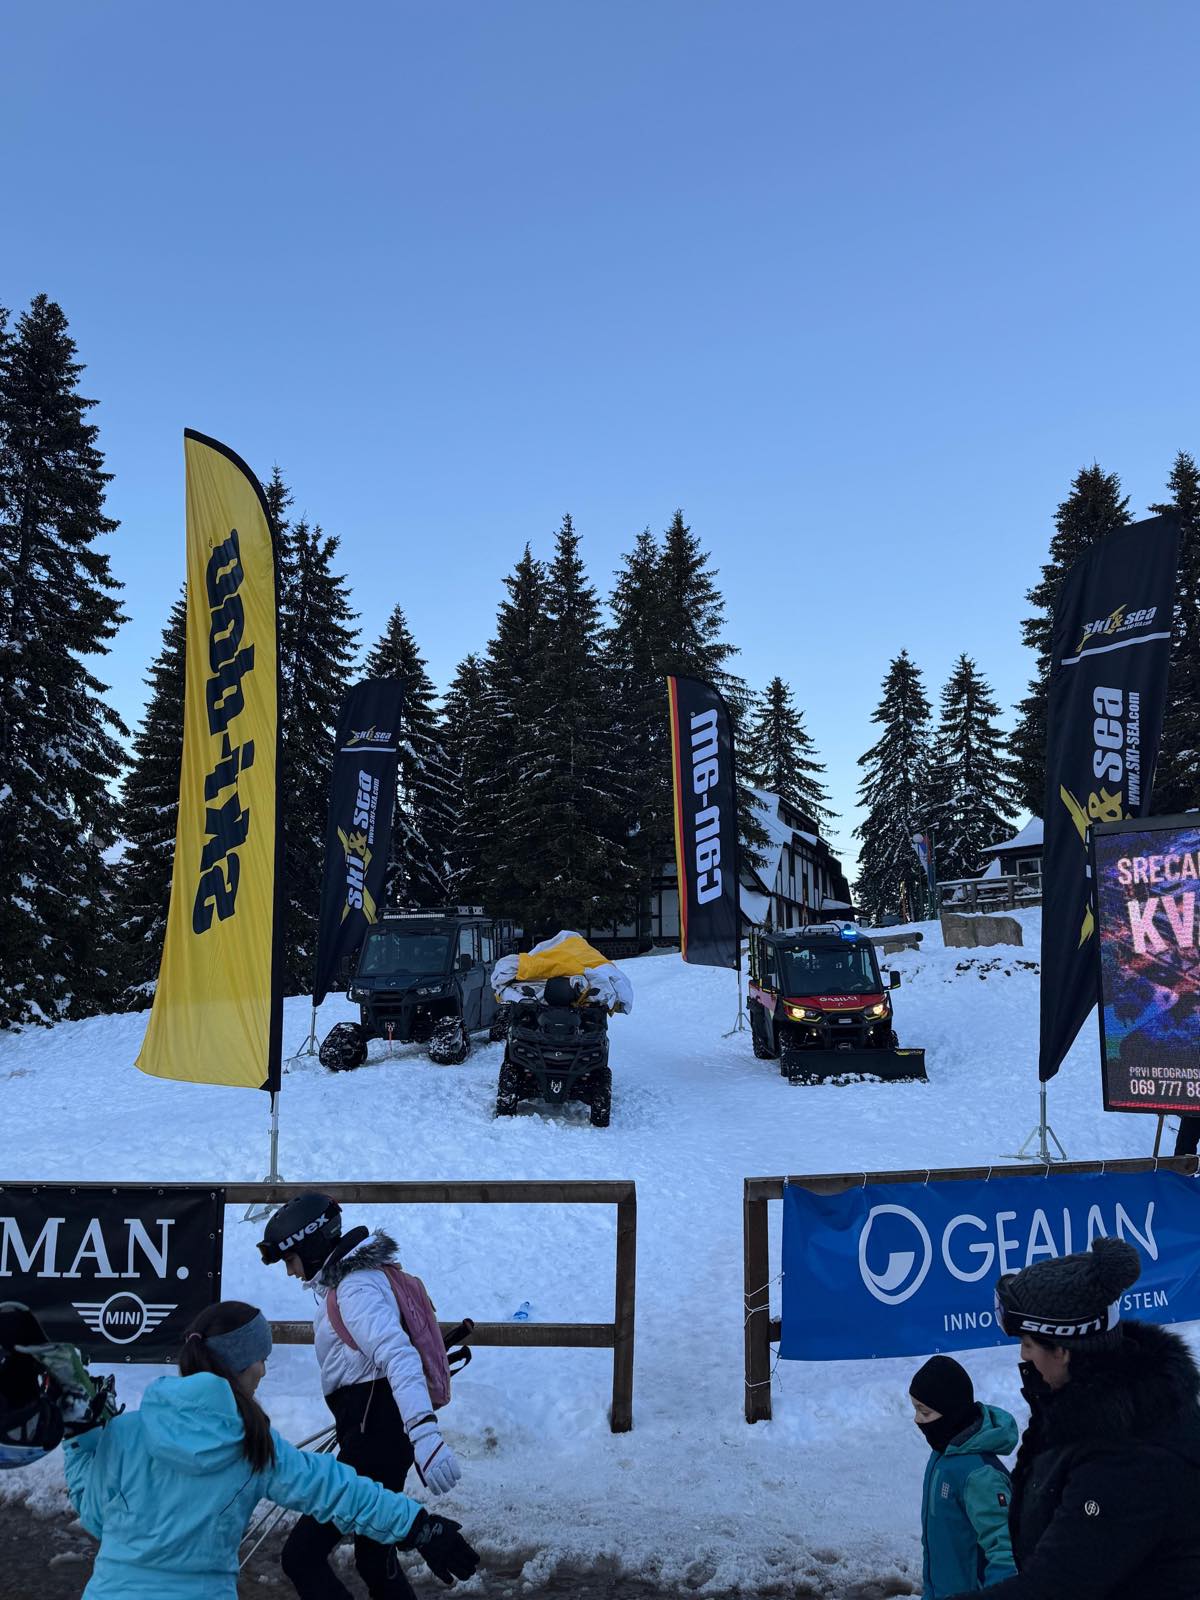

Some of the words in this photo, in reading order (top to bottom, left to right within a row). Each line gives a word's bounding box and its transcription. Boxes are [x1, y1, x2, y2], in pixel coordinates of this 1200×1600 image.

[1126, 692, 1140, 806] www.SKI-SEA.com
[1117, 852, 1200, 885] SRECA
[1127, 891, 1200, 954] KV
[1129, 1066, 1150, 1077] PRVI
[1130, 1079, 1155, 1095] 069
[1158, 1080, 1182, 1097] 777
[0, 1216, 190, 1280] MAN.
[278, 1213, 330, 1251] uvex
[105, 1311, 141, 1325] MINI
[943, 1311, 1001, 1332] INNO
[1115, 1289, 1169, 1311] YSTEM
